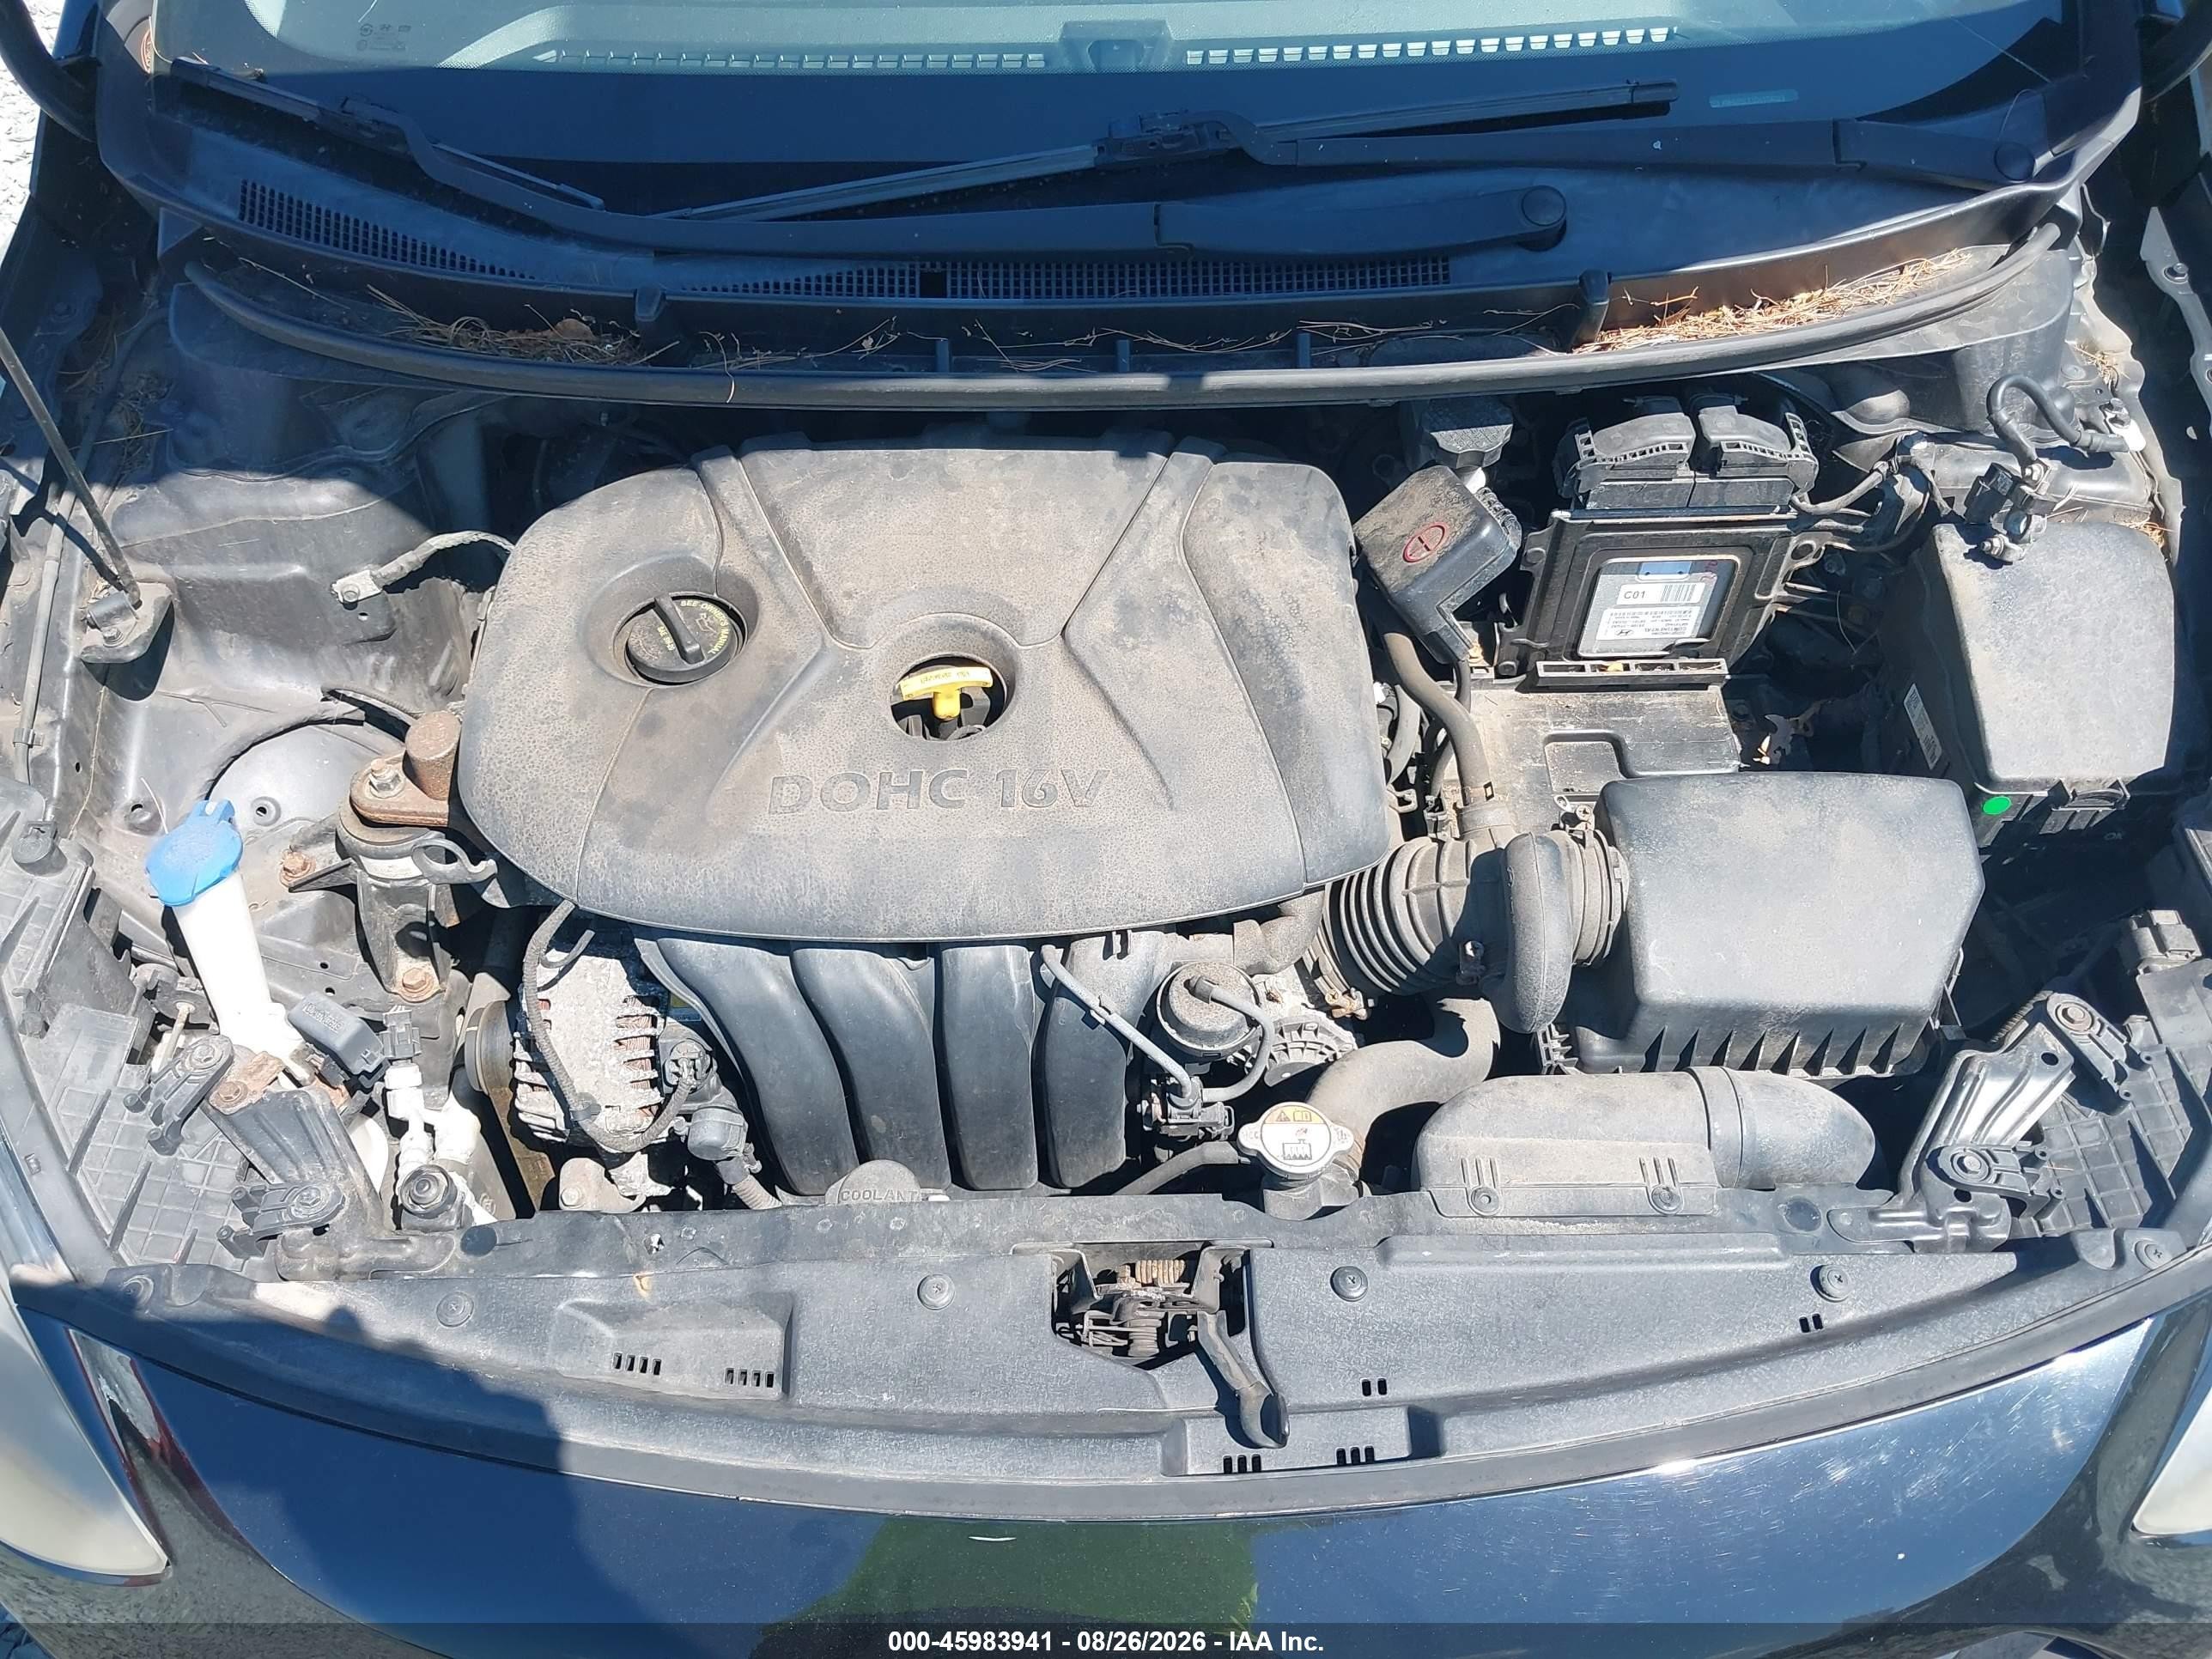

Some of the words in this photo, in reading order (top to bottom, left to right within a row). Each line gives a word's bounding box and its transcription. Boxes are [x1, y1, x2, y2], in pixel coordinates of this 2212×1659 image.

[1624, 591, 1645, 599] C01
[701, 603, 729, 627] OWNER'S
[708, 629, 729, 654] MANUAL
[769, 769, 969, 815] DOHC
[995, 769, 1110, 808] 16V
[841, 1188, 918, 1201] COOLANT
